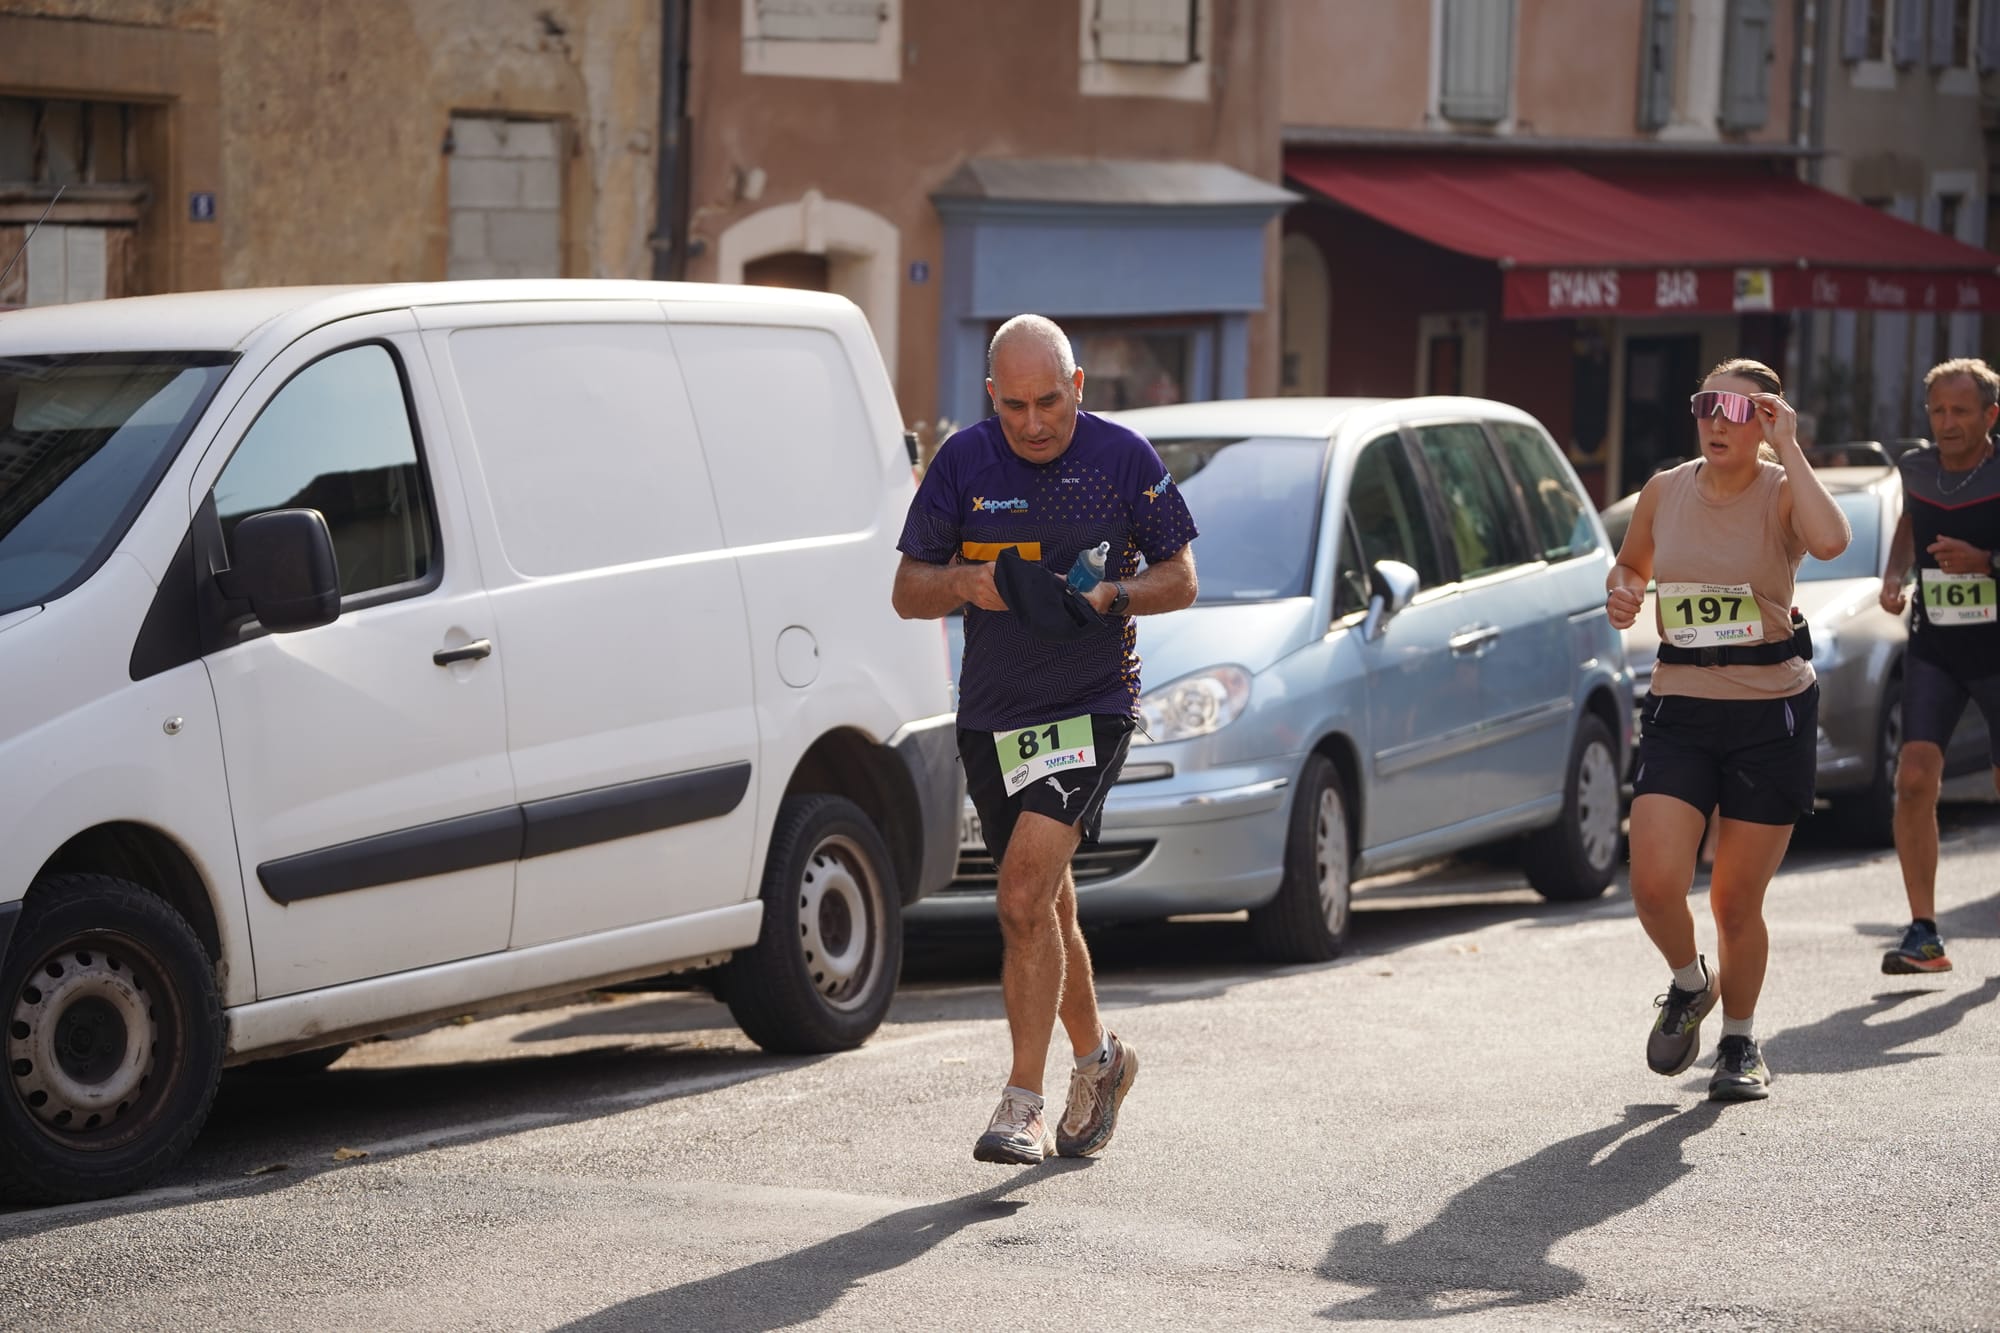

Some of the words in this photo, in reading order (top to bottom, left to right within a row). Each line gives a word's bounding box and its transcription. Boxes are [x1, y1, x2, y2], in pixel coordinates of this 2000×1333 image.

[1548, 271, 1620, 307] RYAN'S
[1656, 271, 1698, 307] BAR
[1931, 583, 1980, 606] 161
[1676, 597, 1742, 625] 197
[1018, 724, 1060, 760] 81
[1044, 754, 1075, 766] TUFF'S
